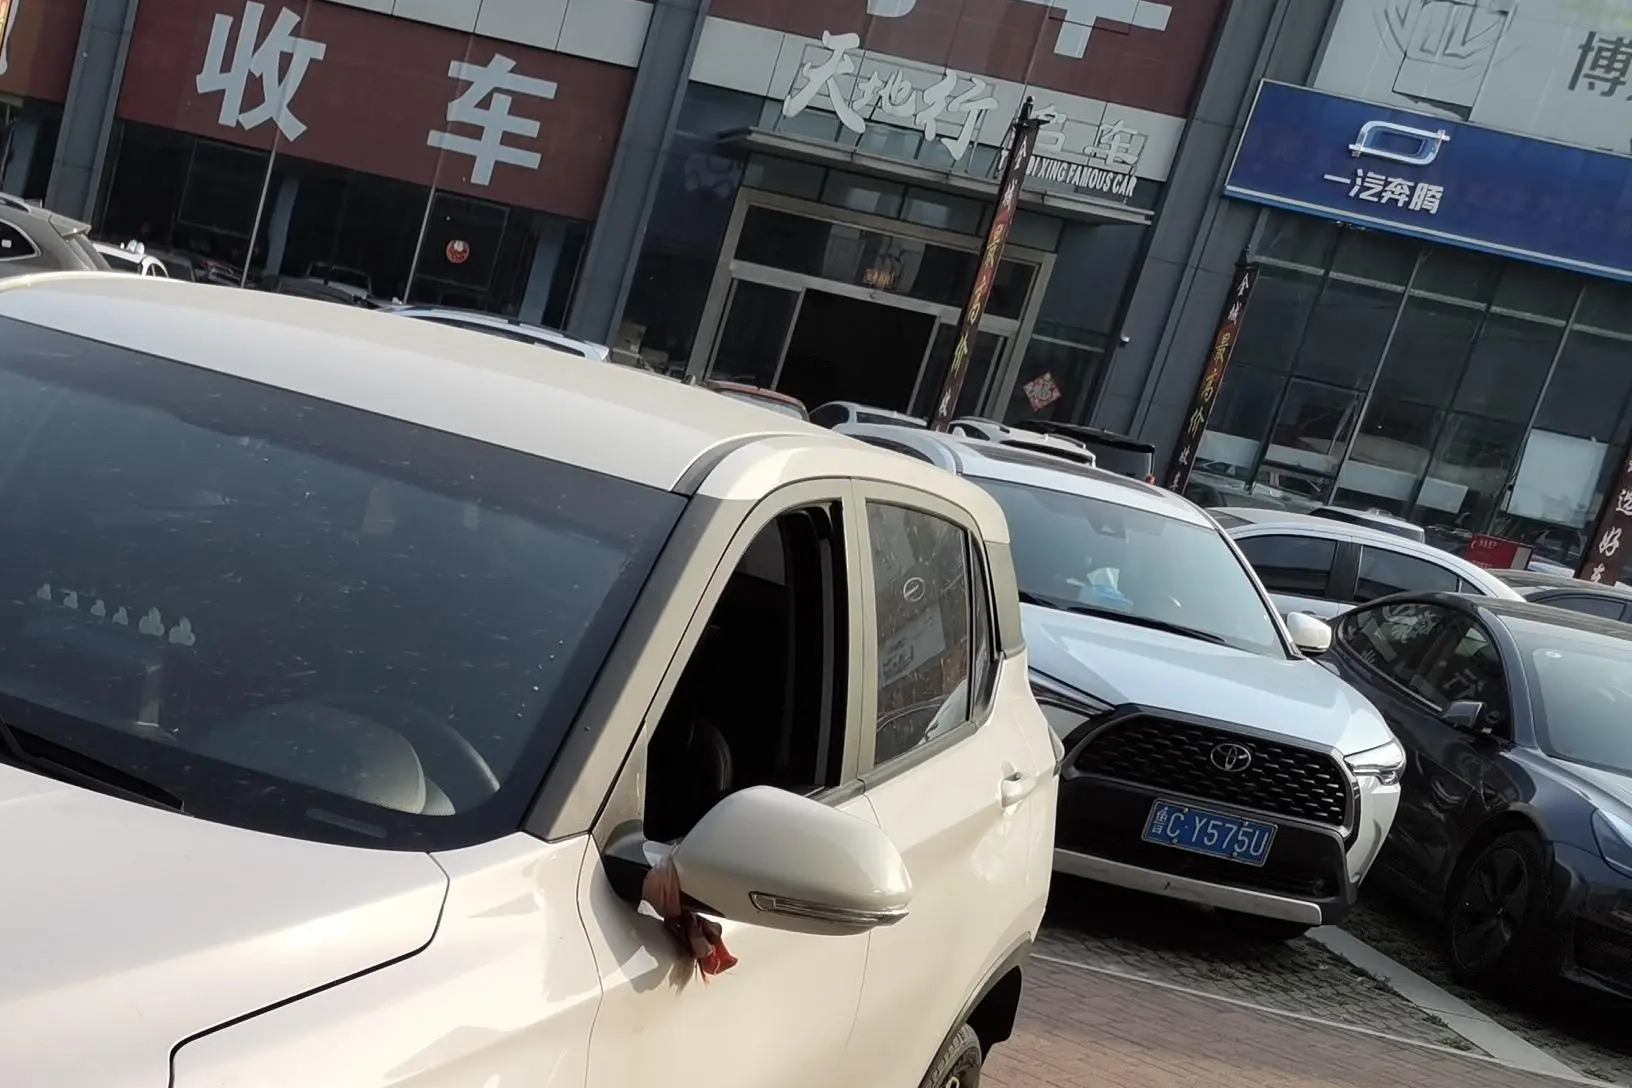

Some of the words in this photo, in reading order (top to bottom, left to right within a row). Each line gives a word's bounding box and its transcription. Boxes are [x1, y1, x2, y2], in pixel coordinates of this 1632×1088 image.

[1067, 163, 1113, 192] FAMOUS
[1112, 172, 1138, 197] CAR
[1323, 168, 1444, 215] 一汽奔腾
